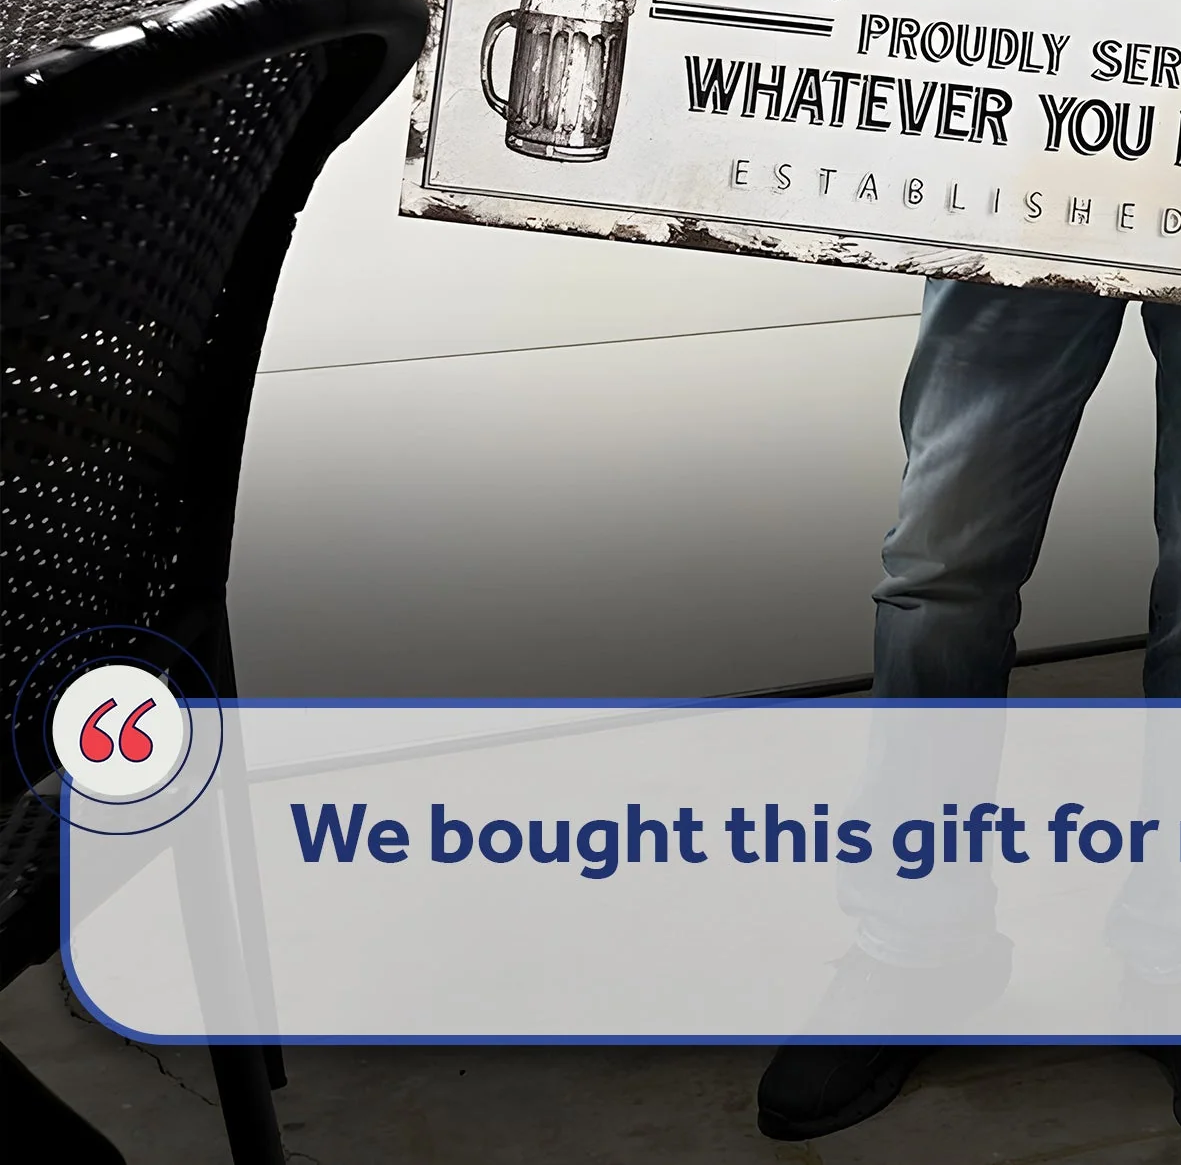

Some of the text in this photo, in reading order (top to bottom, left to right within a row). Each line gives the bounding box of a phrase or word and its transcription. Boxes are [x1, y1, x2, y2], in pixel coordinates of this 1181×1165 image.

[857, 13, 1070, 75] PROUDLY
[684, 55, 1013, 146] WHATEVER
[1038, 92, 1154, 161] YOU
